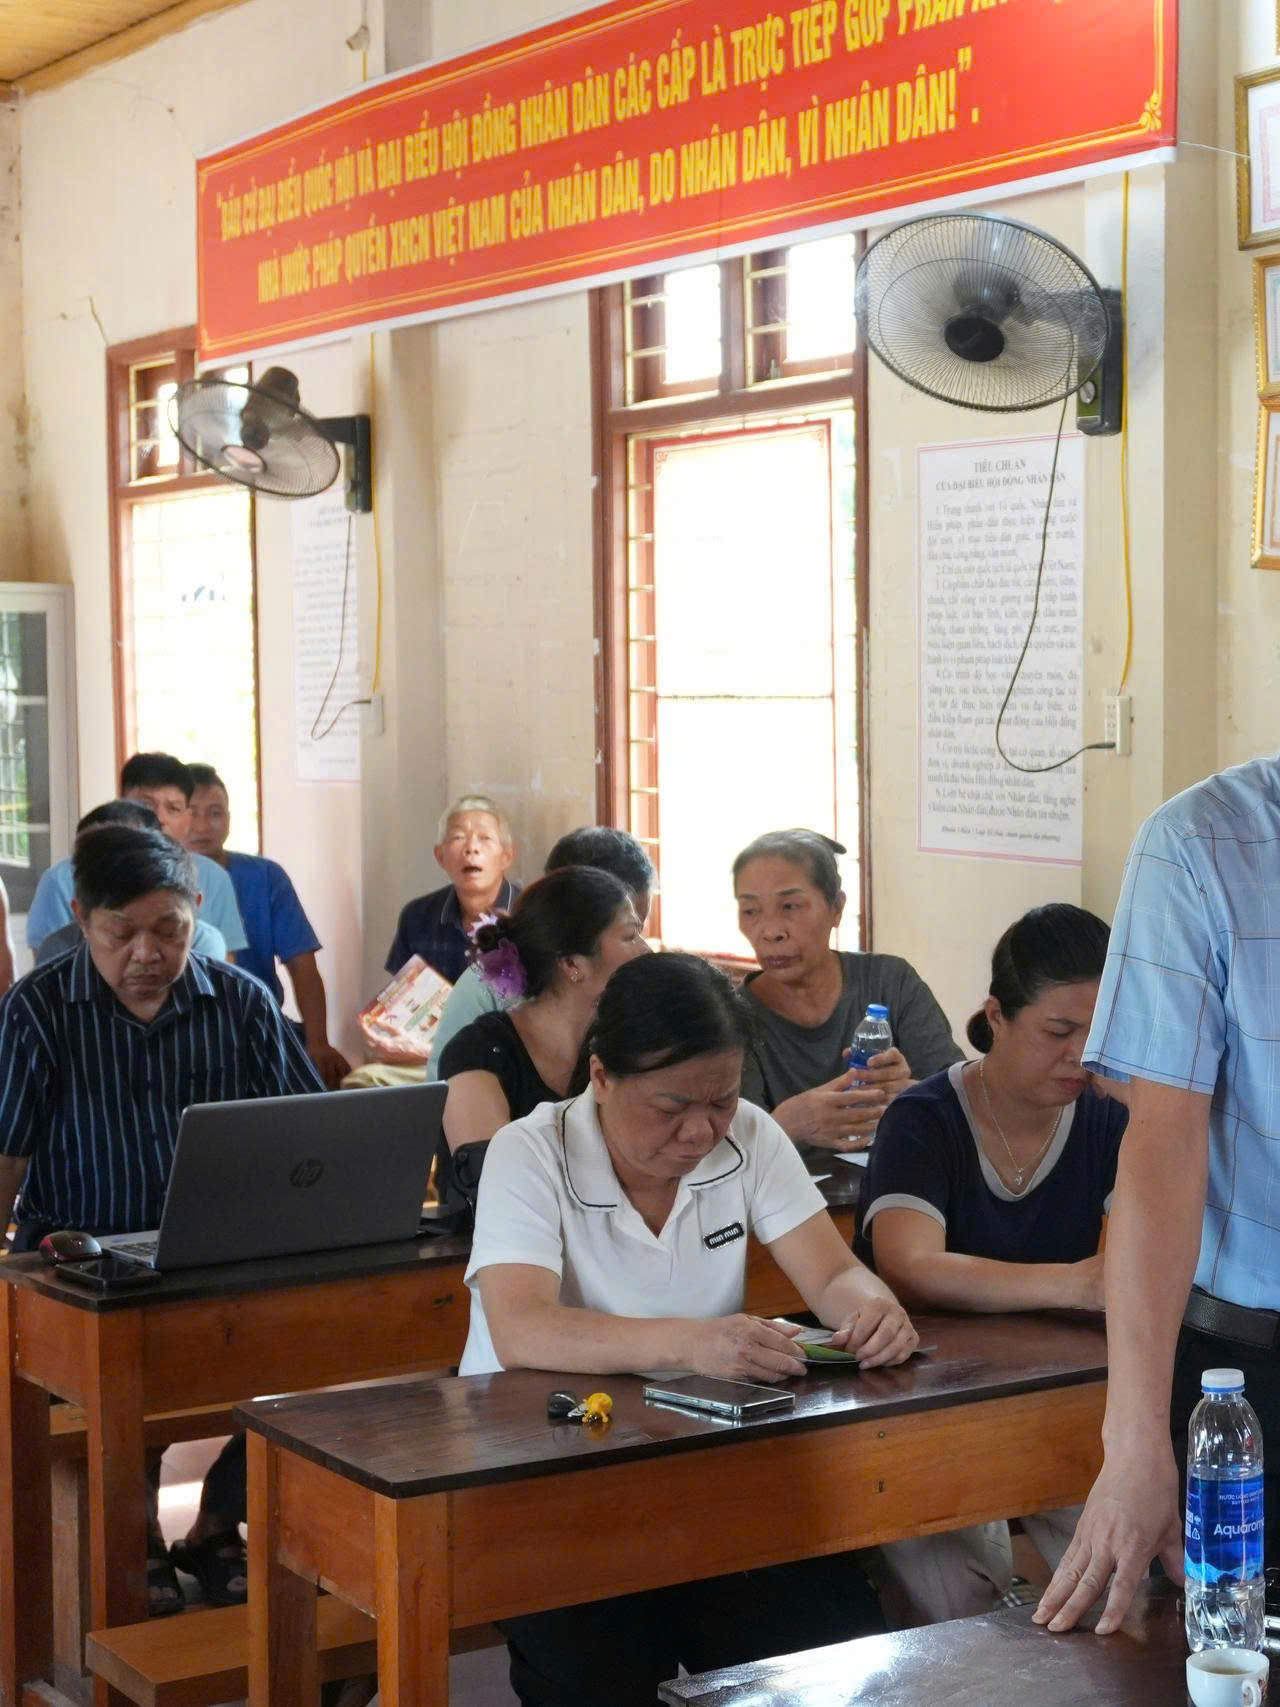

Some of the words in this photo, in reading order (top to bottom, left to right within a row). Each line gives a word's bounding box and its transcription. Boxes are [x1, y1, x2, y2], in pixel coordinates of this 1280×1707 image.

[389, 213, 432, 269] XHCN
[434, 196, 465, 266] VIỆT
[469, 193, 506, 250] NAM
[510, 170, 544, 240] CỦA
[548, 162, 597, 231] NHÂN
[601, 150, 646, 218] DÂN,
[650, 148, 676, 206] DO
[680, 123, 737, 199] NHÂN
[742, 109, 792, 183] DÂN,
[798, 94, 820, 170] VÌ
[824, 80, 890, 163] NHÂN
[404, 109, 440, 184] BIỂU
[442, 109, 468, 180] HỘI
[472, 91, 517, 163] ĐỒNG
[520, 80, 568, 149] NHÂN
[572, 66, 610, 135] DÂN
[614, 51, 652, 122] CÁC
[657, 27, 697, 110] CẤP
[700, 24, 728, 96] LÀ
[730, 13, 785, 92] TRỰC
